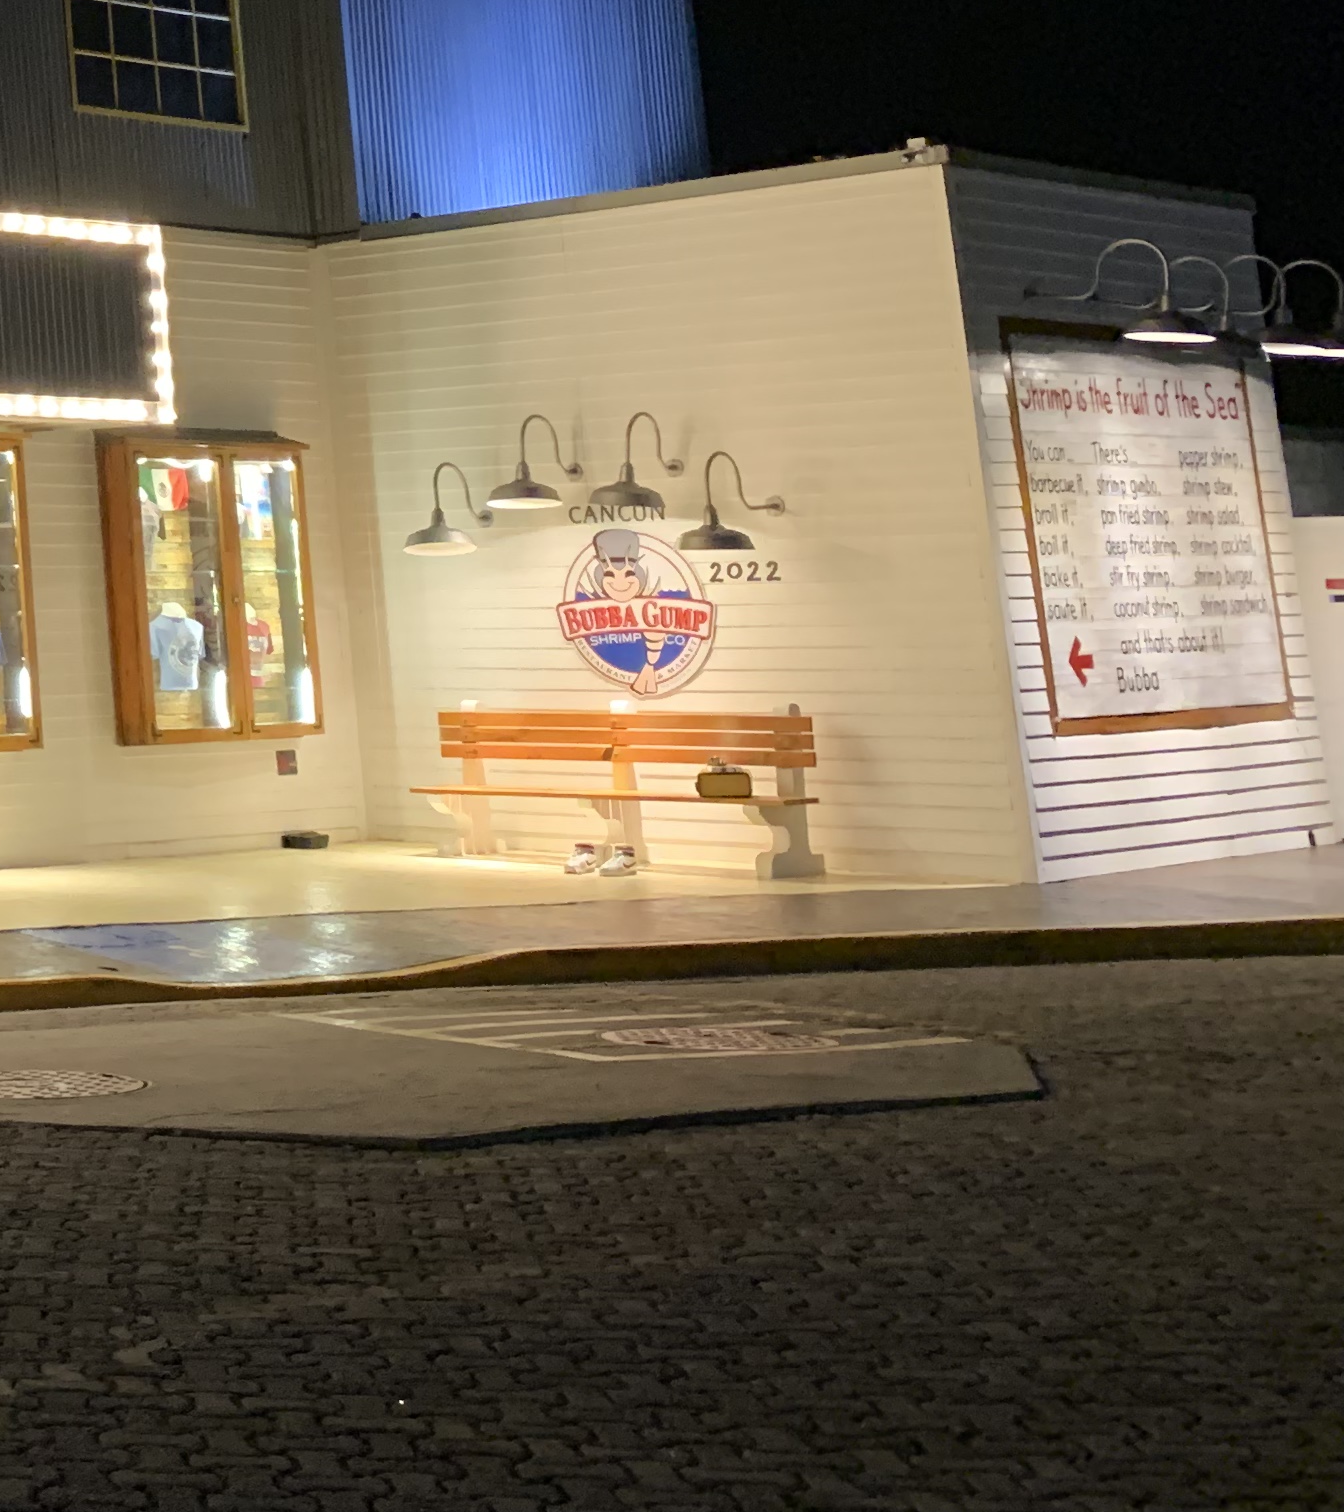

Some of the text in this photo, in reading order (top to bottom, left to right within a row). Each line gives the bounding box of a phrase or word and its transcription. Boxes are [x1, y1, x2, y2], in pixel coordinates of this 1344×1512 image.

[1074, 379, 1087, 413] is
[1089, 377, 1114, 415] the
[1116, 377, 1150, 417] fruit
[1155, 379, 1171, 419] of
[1175, 379, 1201, 420] the
[1025, 439, 1045, 462] You
[1097, 473, 1127, 500] shrimp
[1034, 503, 1058, 525] broil
[1101, 508, 1118, 529] pan
[1119, 503, 1141, 525] fried
[1039, 534, 1059, 555] boil
[1105, 534, 1128, 561] deep
[1130, 533, 1151, 555] fried
[709, 560, 782, 583] 2022
[1043, 565, 1071, 588] bake
[1126, 564, 1140, 592] fry
[563, 600, 708, 635] BUBBA GUMP
[1047, 598, 1078, 620] saute
[1114, 594, 1151, 617] coconut
[589, 632, 642, 647] SHRIMP
[1120, 631, 1142, 654] and
[1178, 627, 1207, 653] about
[577, 639, 632, 682] RESTAURANT
[667, 639, 699, 675] MARKET
[1116, 666, 1160, 694] Bubba
